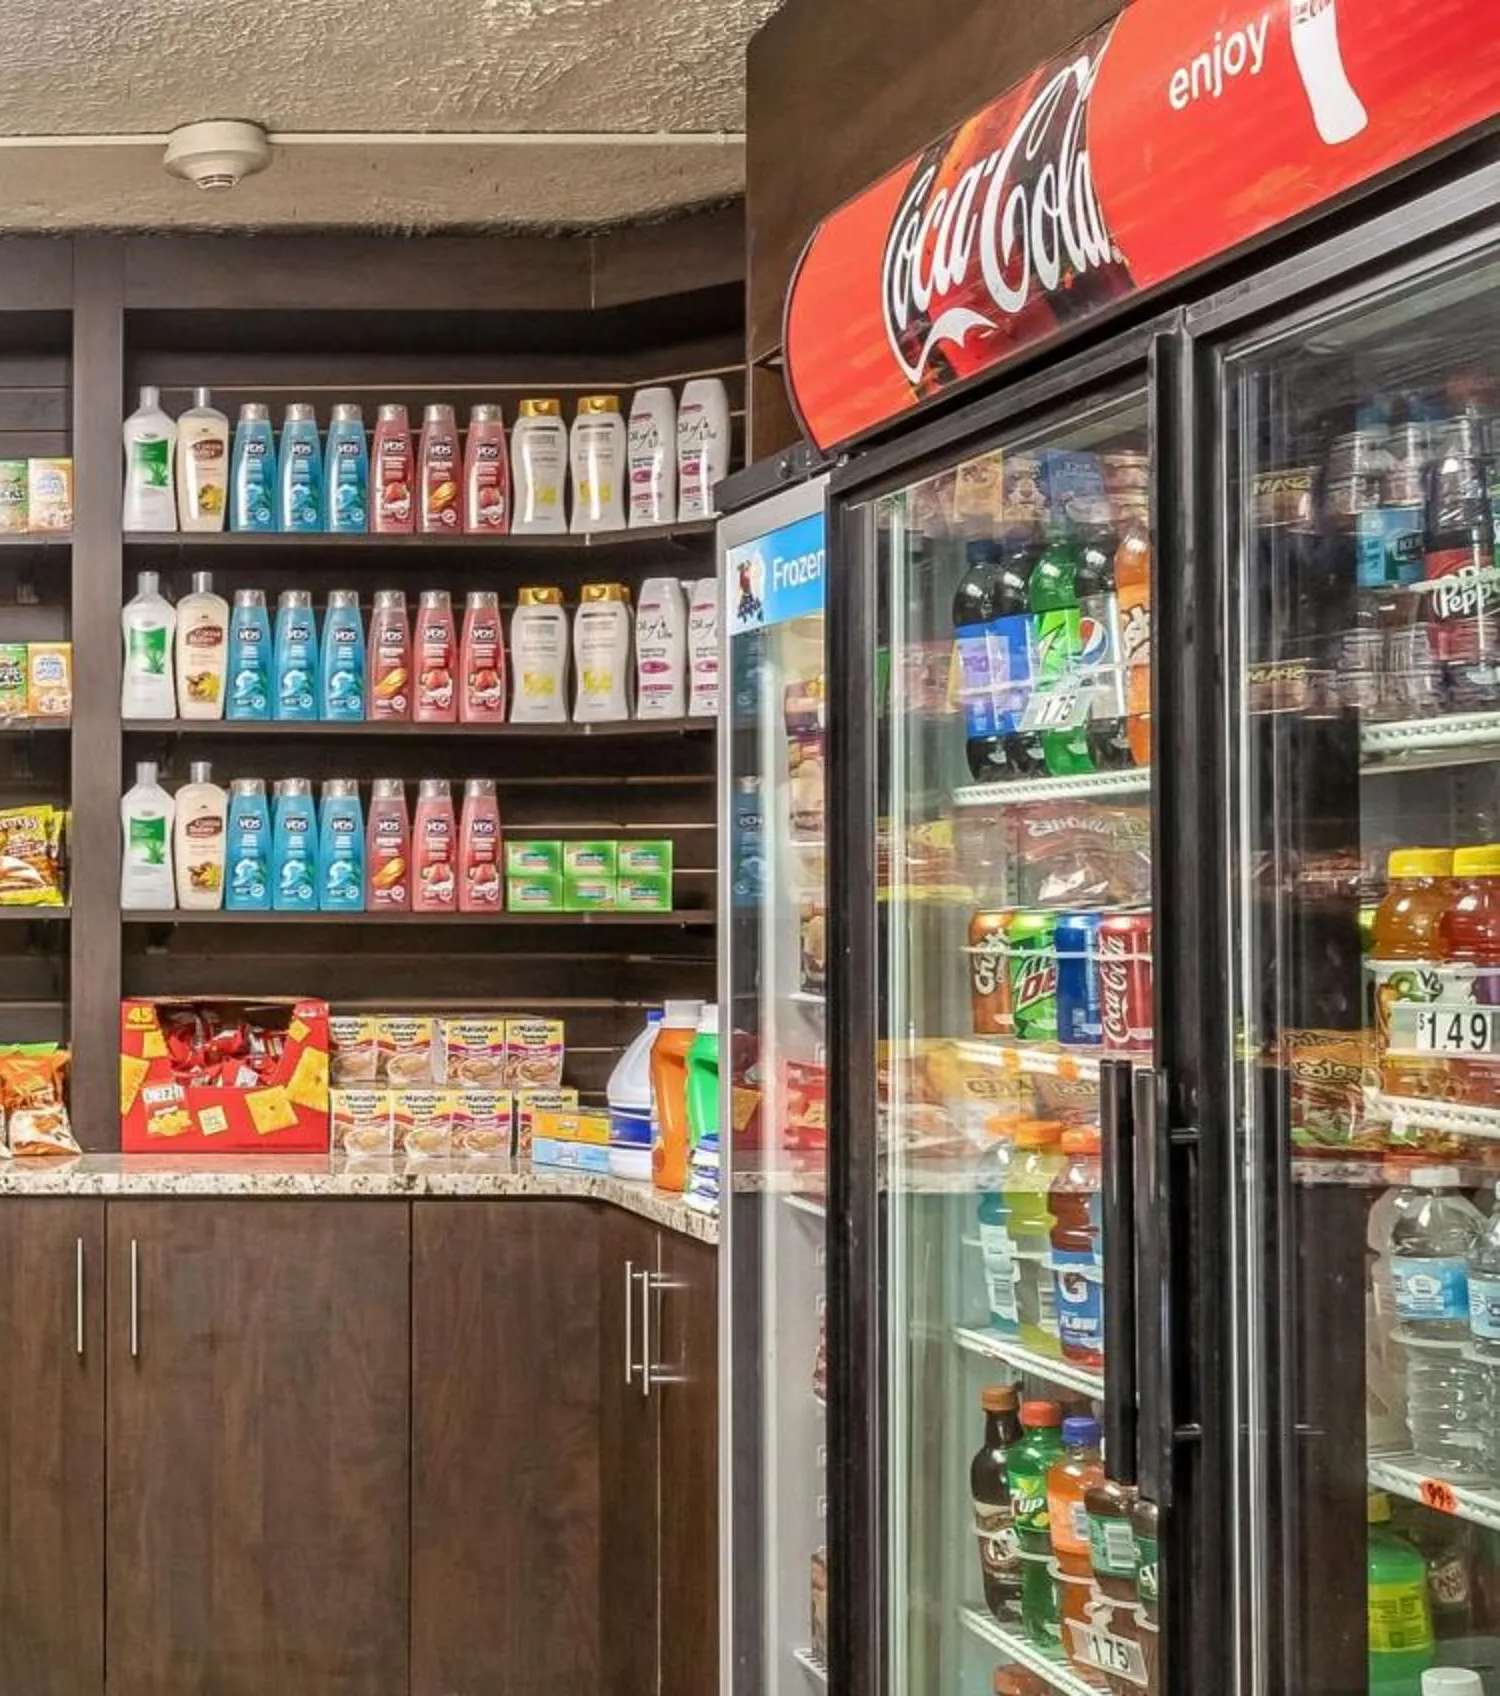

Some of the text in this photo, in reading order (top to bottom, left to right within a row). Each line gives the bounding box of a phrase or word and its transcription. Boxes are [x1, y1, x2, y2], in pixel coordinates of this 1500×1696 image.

[1168, 13, 1270, 110] enjoy
[881, 55, 1115, 383] Coca-Cola
[773, 548, 825, 593] Frozen
[1434, 576, 1500, 619] Pepp
